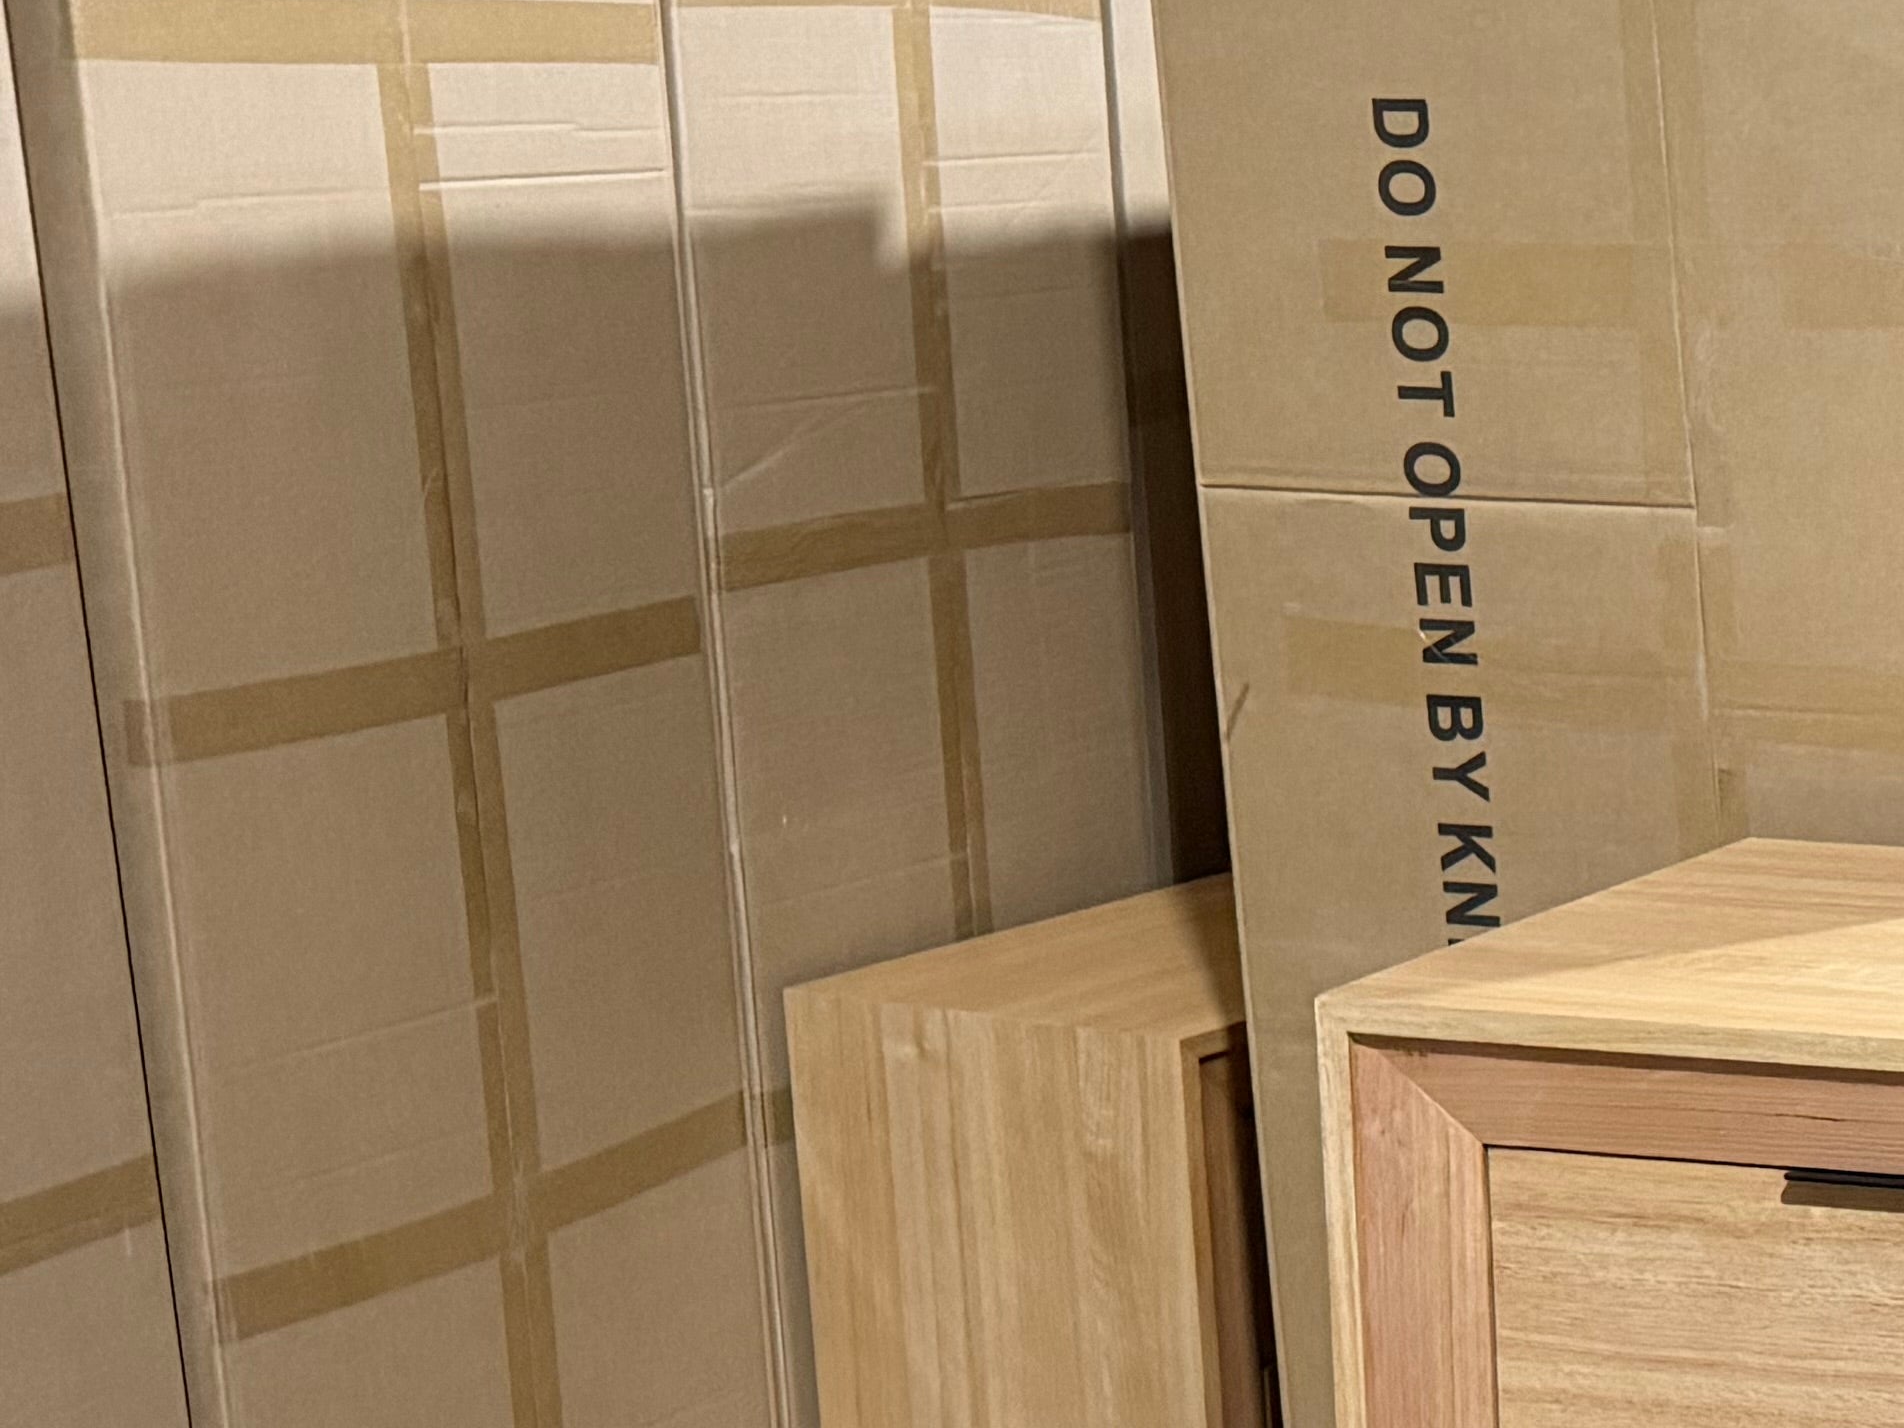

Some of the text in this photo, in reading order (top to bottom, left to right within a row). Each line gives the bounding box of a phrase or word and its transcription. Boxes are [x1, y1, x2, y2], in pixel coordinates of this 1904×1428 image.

[1371, 98, 1501, 946] DO NOT OPEN BY KN
